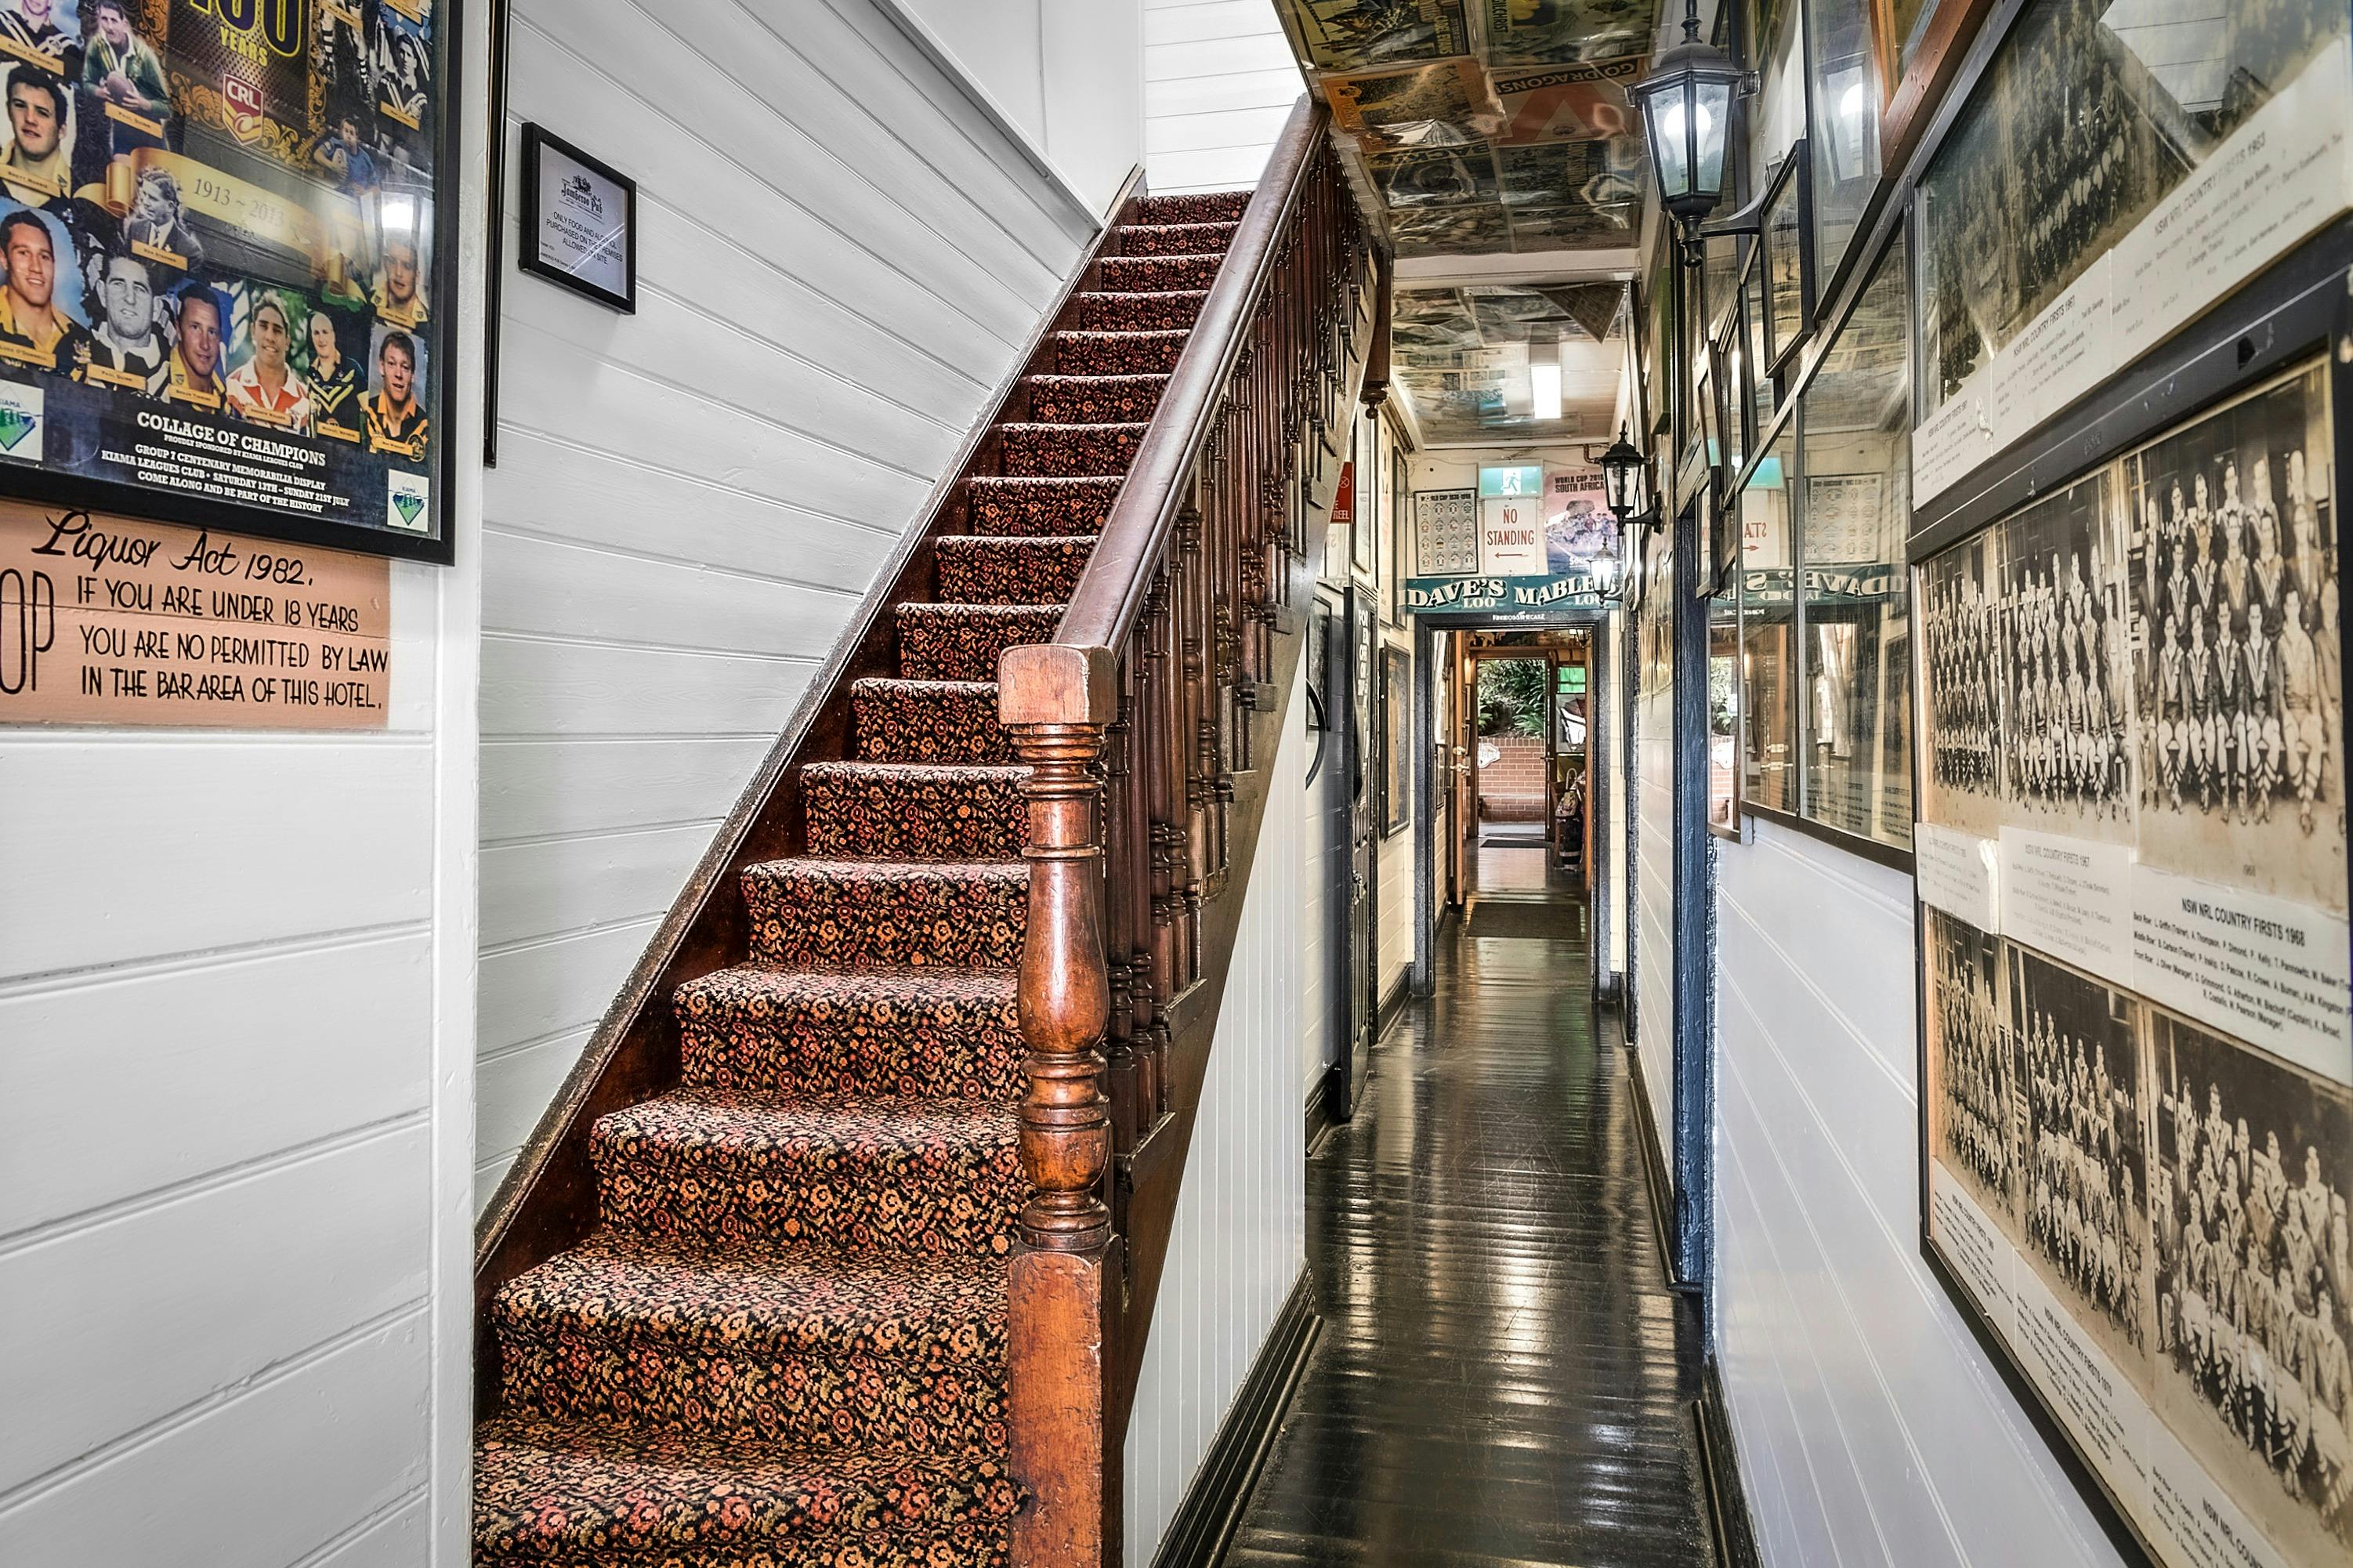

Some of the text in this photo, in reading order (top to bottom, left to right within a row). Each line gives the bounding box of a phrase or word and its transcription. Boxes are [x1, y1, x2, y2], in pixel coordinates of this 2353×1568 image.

[219, 26, 269, 67] YEARS
[1605, 63, 1635, 77] GO
[226, 81, 259, 111] CRL
[194, 178, 284, 227] 1913 2013
[591, 197, 603, 214] Pub
[546, 219, 579, 240] PURCHASED
[580, 234, 588, 244] ON
[553, 212, 567, 224] ONLY
[568, 219, 584, 232] FOOD
[584, 226, 595, 237] AND
[563, 237, 588, 254] ALLOWED
[137, 411, 215, 441] COLLAGE
[217, 430, 239, 447] OF
[241, 436, 326, 466] CHAMPIONS
[164, 434, 304, 470] PROUDLY SPONSORED BY KIAMA LEAGUES CLUB
[102, 450, 350, 508] KIAMA LEAGUES CLUB SATURDAY 13TH SUNDAY 21ST JULY
[135, 444, 326, 491] GROUP 7 CENTENARY MEMORABILIA DISPLAY
[1555, 476, 1576, 484] WORLD
[1577, 475, 1588, 483] CUP
[137, 470, 323, 512] COME ALONG AND BE PART OF THE HISTORY
[1555, 481, 1605, 493] SOUTH AFRICA
[1503, 508, 1518, 524] NO
[31, 508, 162, 573] Liquor
[167, 528, 241, 576] Act
[1487, 530, 1535, 545] STANDING
[77, 575, 358, 632] IF YOU ARE UNDER 18 YEARS
[1408, 578, 1507, 607] DAVE'S
[1463, 597, 1496, 608] LOO
[80, 625, 388, 673] YOU ARE NO PERMITTED BY LAW
[81, 665, 101, 695] IN
[110, 668, 148, 698] THE
[252, 676, 277, 703] OF
[281, 679, 319, 706] THIS
[325, 683, 382, 709] HOTEL.
[2182, 897, 2305, 947] NSW NRL COUNTRY FIRSTS 1968
